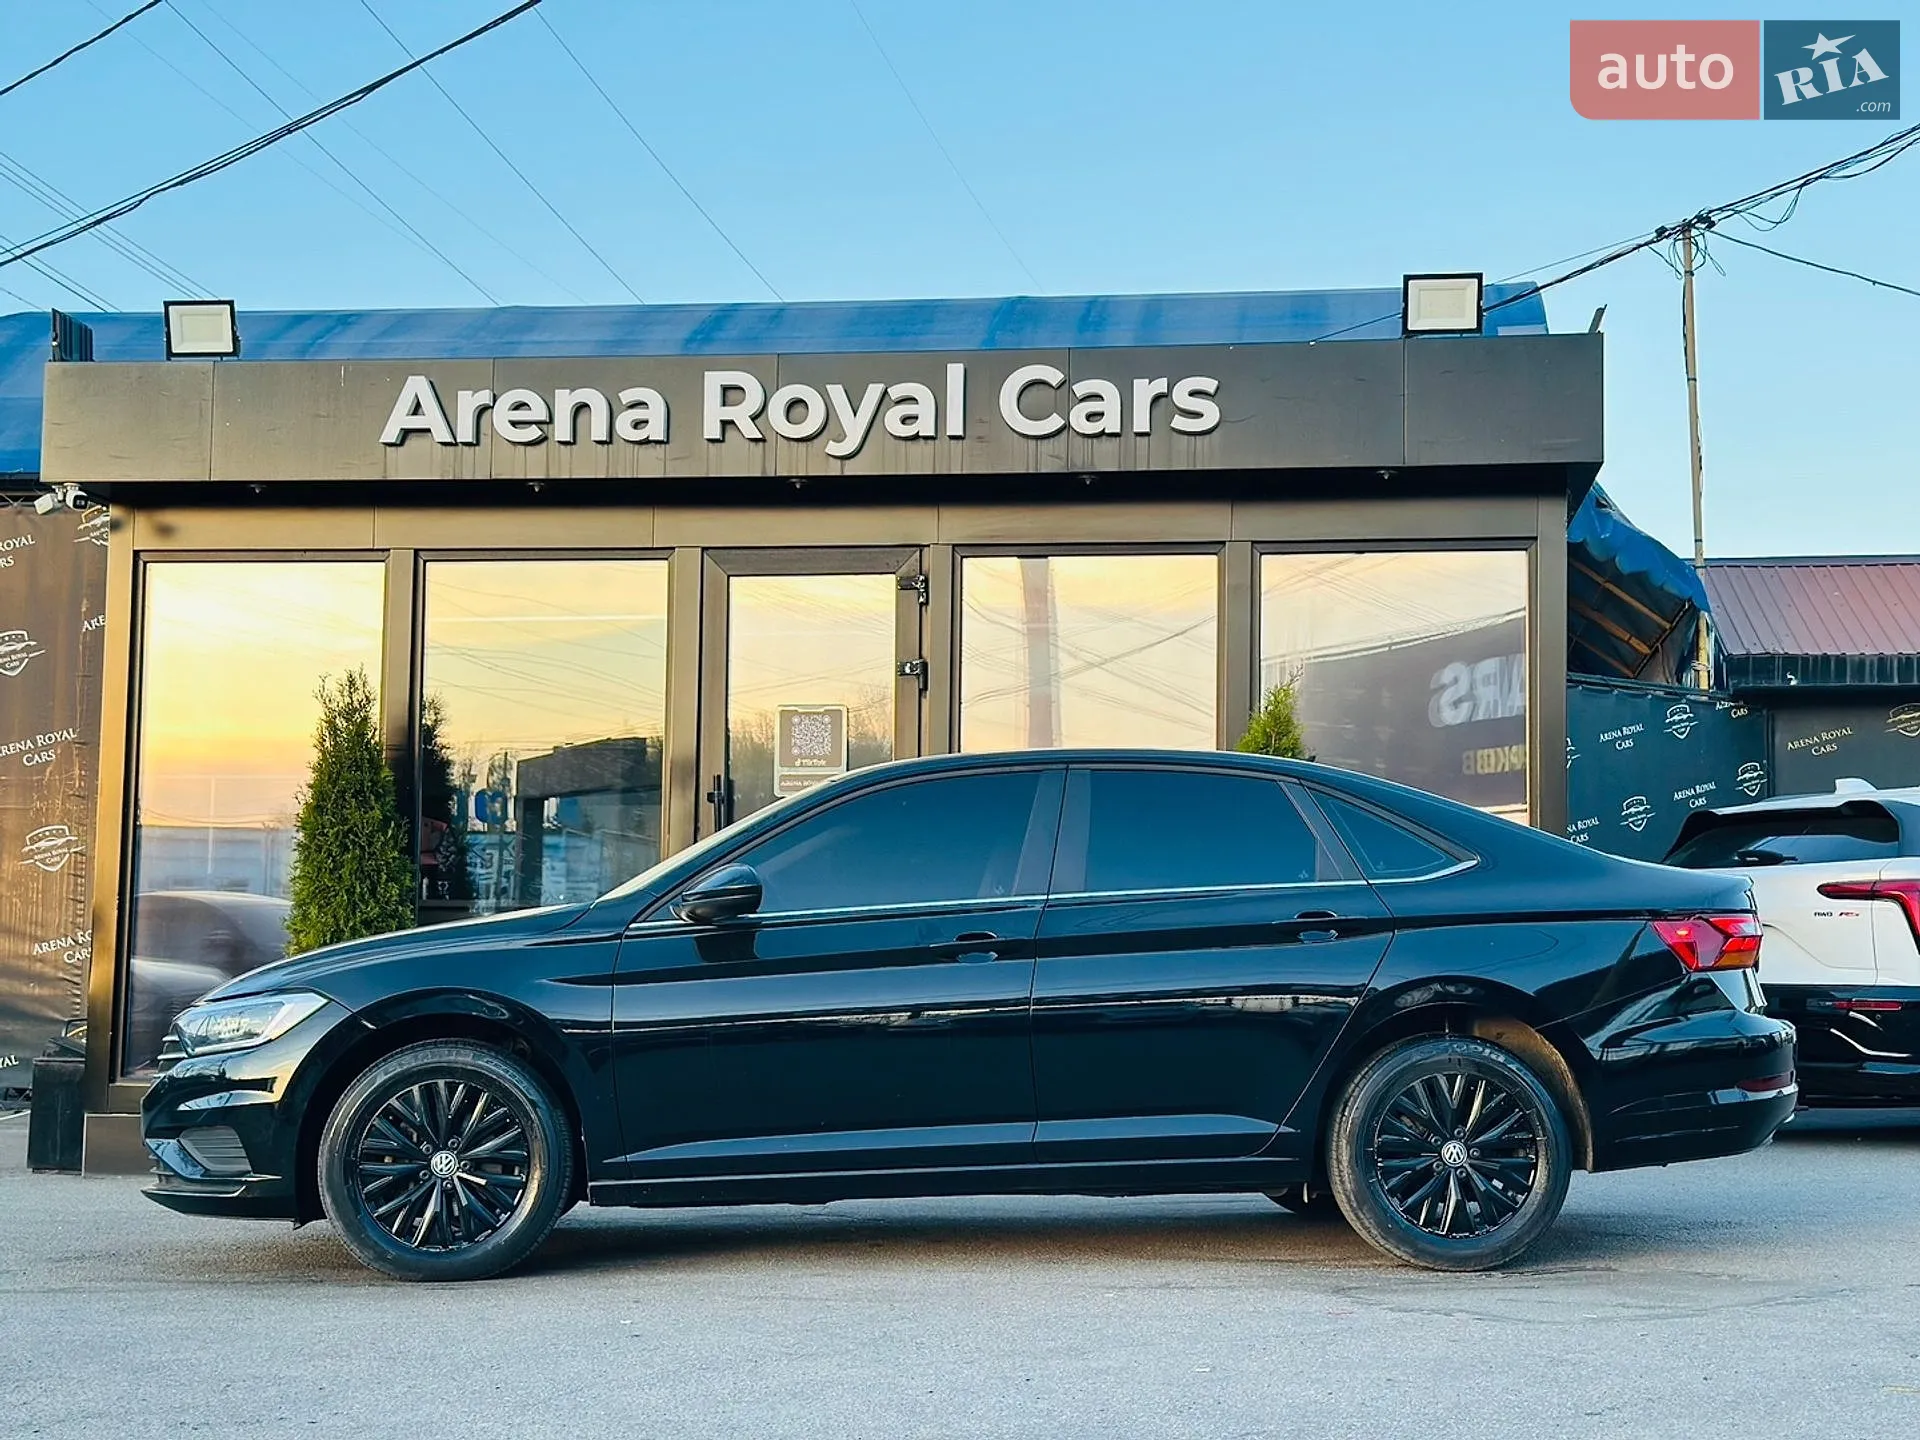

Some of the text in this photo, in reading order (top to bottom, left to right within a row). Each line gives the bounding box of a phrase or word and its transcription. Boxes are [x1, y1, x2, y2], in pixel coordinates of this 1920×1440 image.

[379, 362, 1222, 460] Arena Royal Cars
[82, 614, 105, 632] ARE
[0, 727, 77, 758] RENA ROYAL
[1615, 739, 1634, 751] CARS
[1787, 726, 1853, 751] ARENA ROYAL
[22, 748, 56, 767] CARS
[1811, 742, 1838, 756] CARS
[32, 935, 76, 956] ARENA
